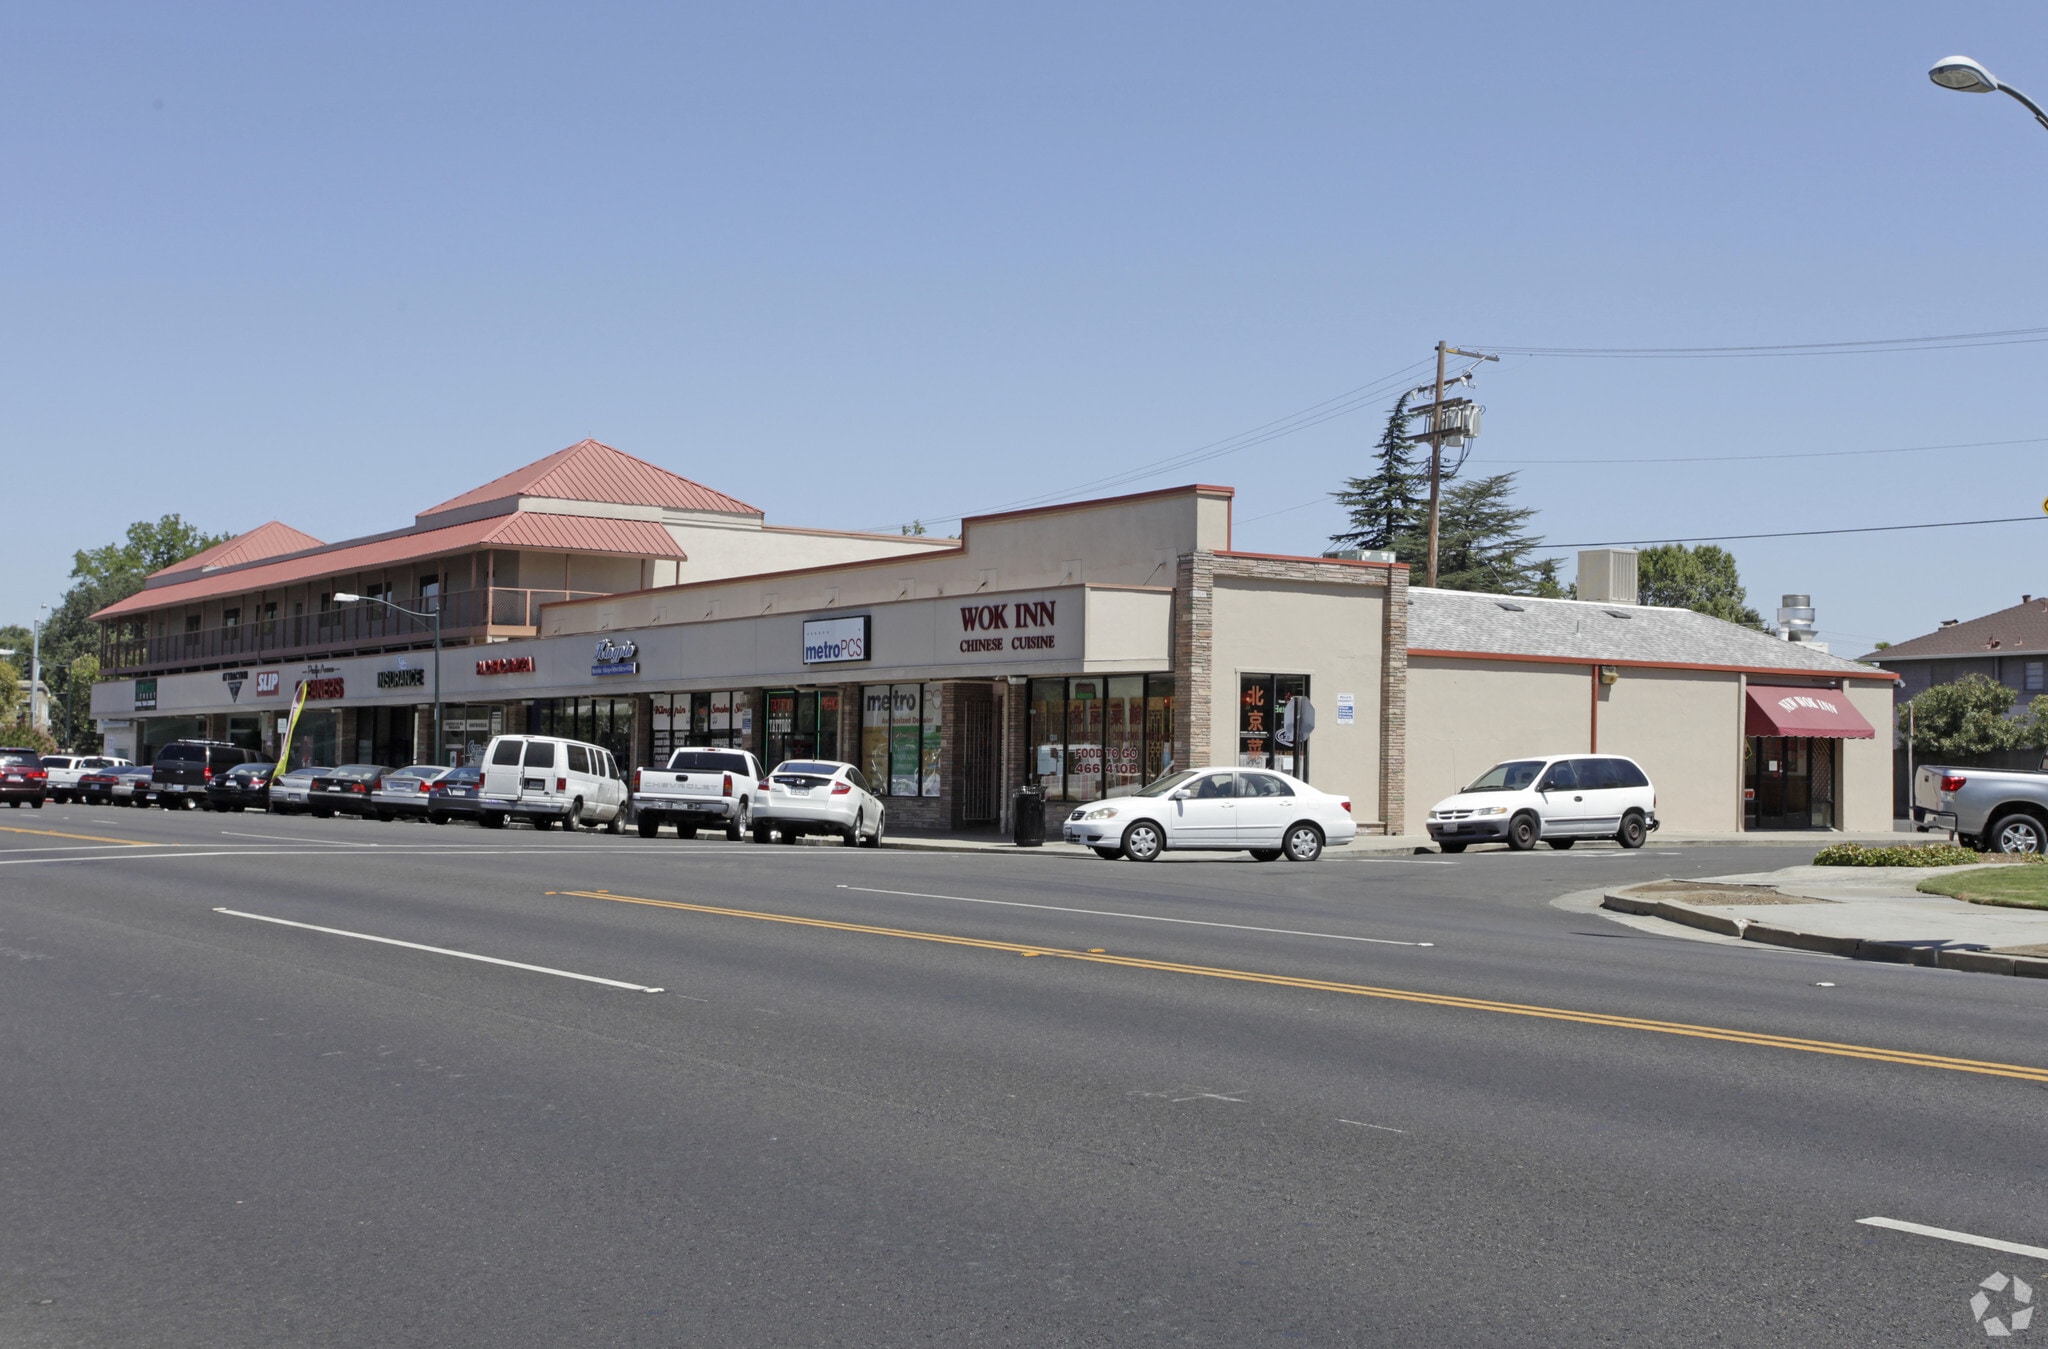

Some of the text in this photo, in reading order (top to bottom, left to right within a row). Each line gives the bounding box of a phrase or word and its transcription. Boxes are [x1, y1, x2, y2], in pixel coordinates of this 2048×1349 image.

[960, 600, 1056, 632] WOK INN
[593, 639, 636, 663] Kingpin
[806, 638, 862, 660] metroPCS
[960, 635, 1055, 653] CHINESE CUISINE
[257, 673, 279, 691] SLIP
[378, 669, 424, 688] INSURANCE
[295, 677, 345, 700] EANERS
[1793, 696, 1819, 709] WOK
[1816, 699, 1838, 714] INN
[1075, 748, 1138, 759] FOOD TO GO
[1075, 763, 1137, 774] 466 4108
[644, 782, 719, 790] CHEVROLET
